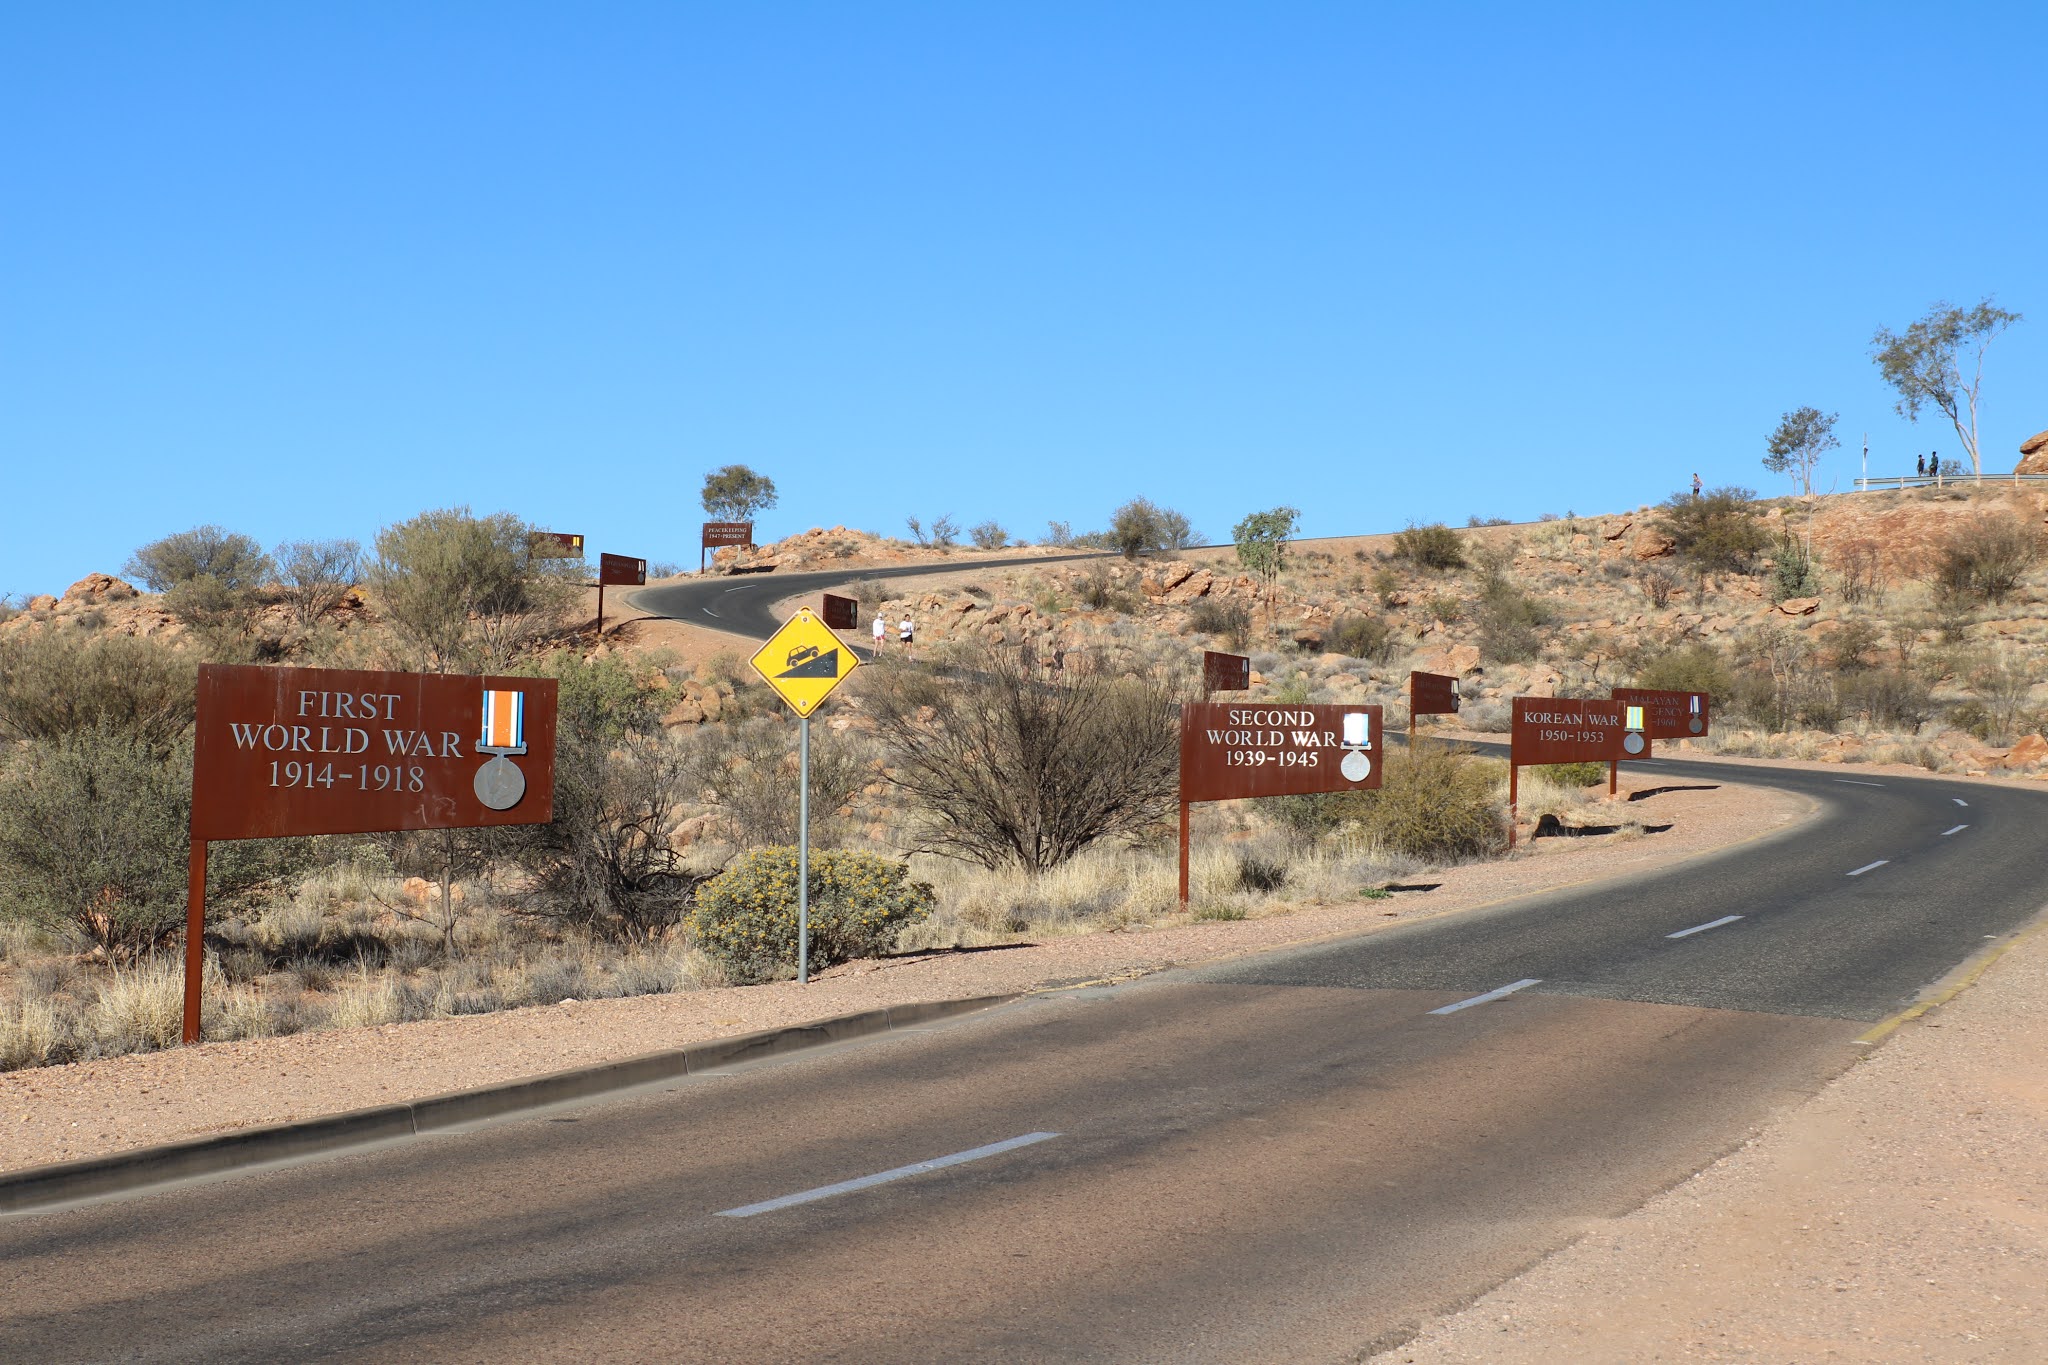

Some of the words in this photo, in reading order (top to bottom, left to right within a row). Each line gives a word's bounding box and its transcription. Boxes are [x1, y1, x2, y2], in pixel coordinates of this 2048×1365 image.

[297, 690, 401, 720] FIRST
[1229, 710, 1315, 727] SECOND
[1523, 711, 1583, 726] KOREAN
[1588, 714, 1620, 726] WAR
[229, 723, 369, 754] WORLD
[382, 729, 464, 758] WAR
[1206, 730, 1285, 747] WORLD
[1290, 731, 1338, 747] WAR
[1539, 729, 1604, 743] 1950-1953
[1226, 750, 1318, 767] 1939-1945
[269, 761, 424, 792] 1914-1918
